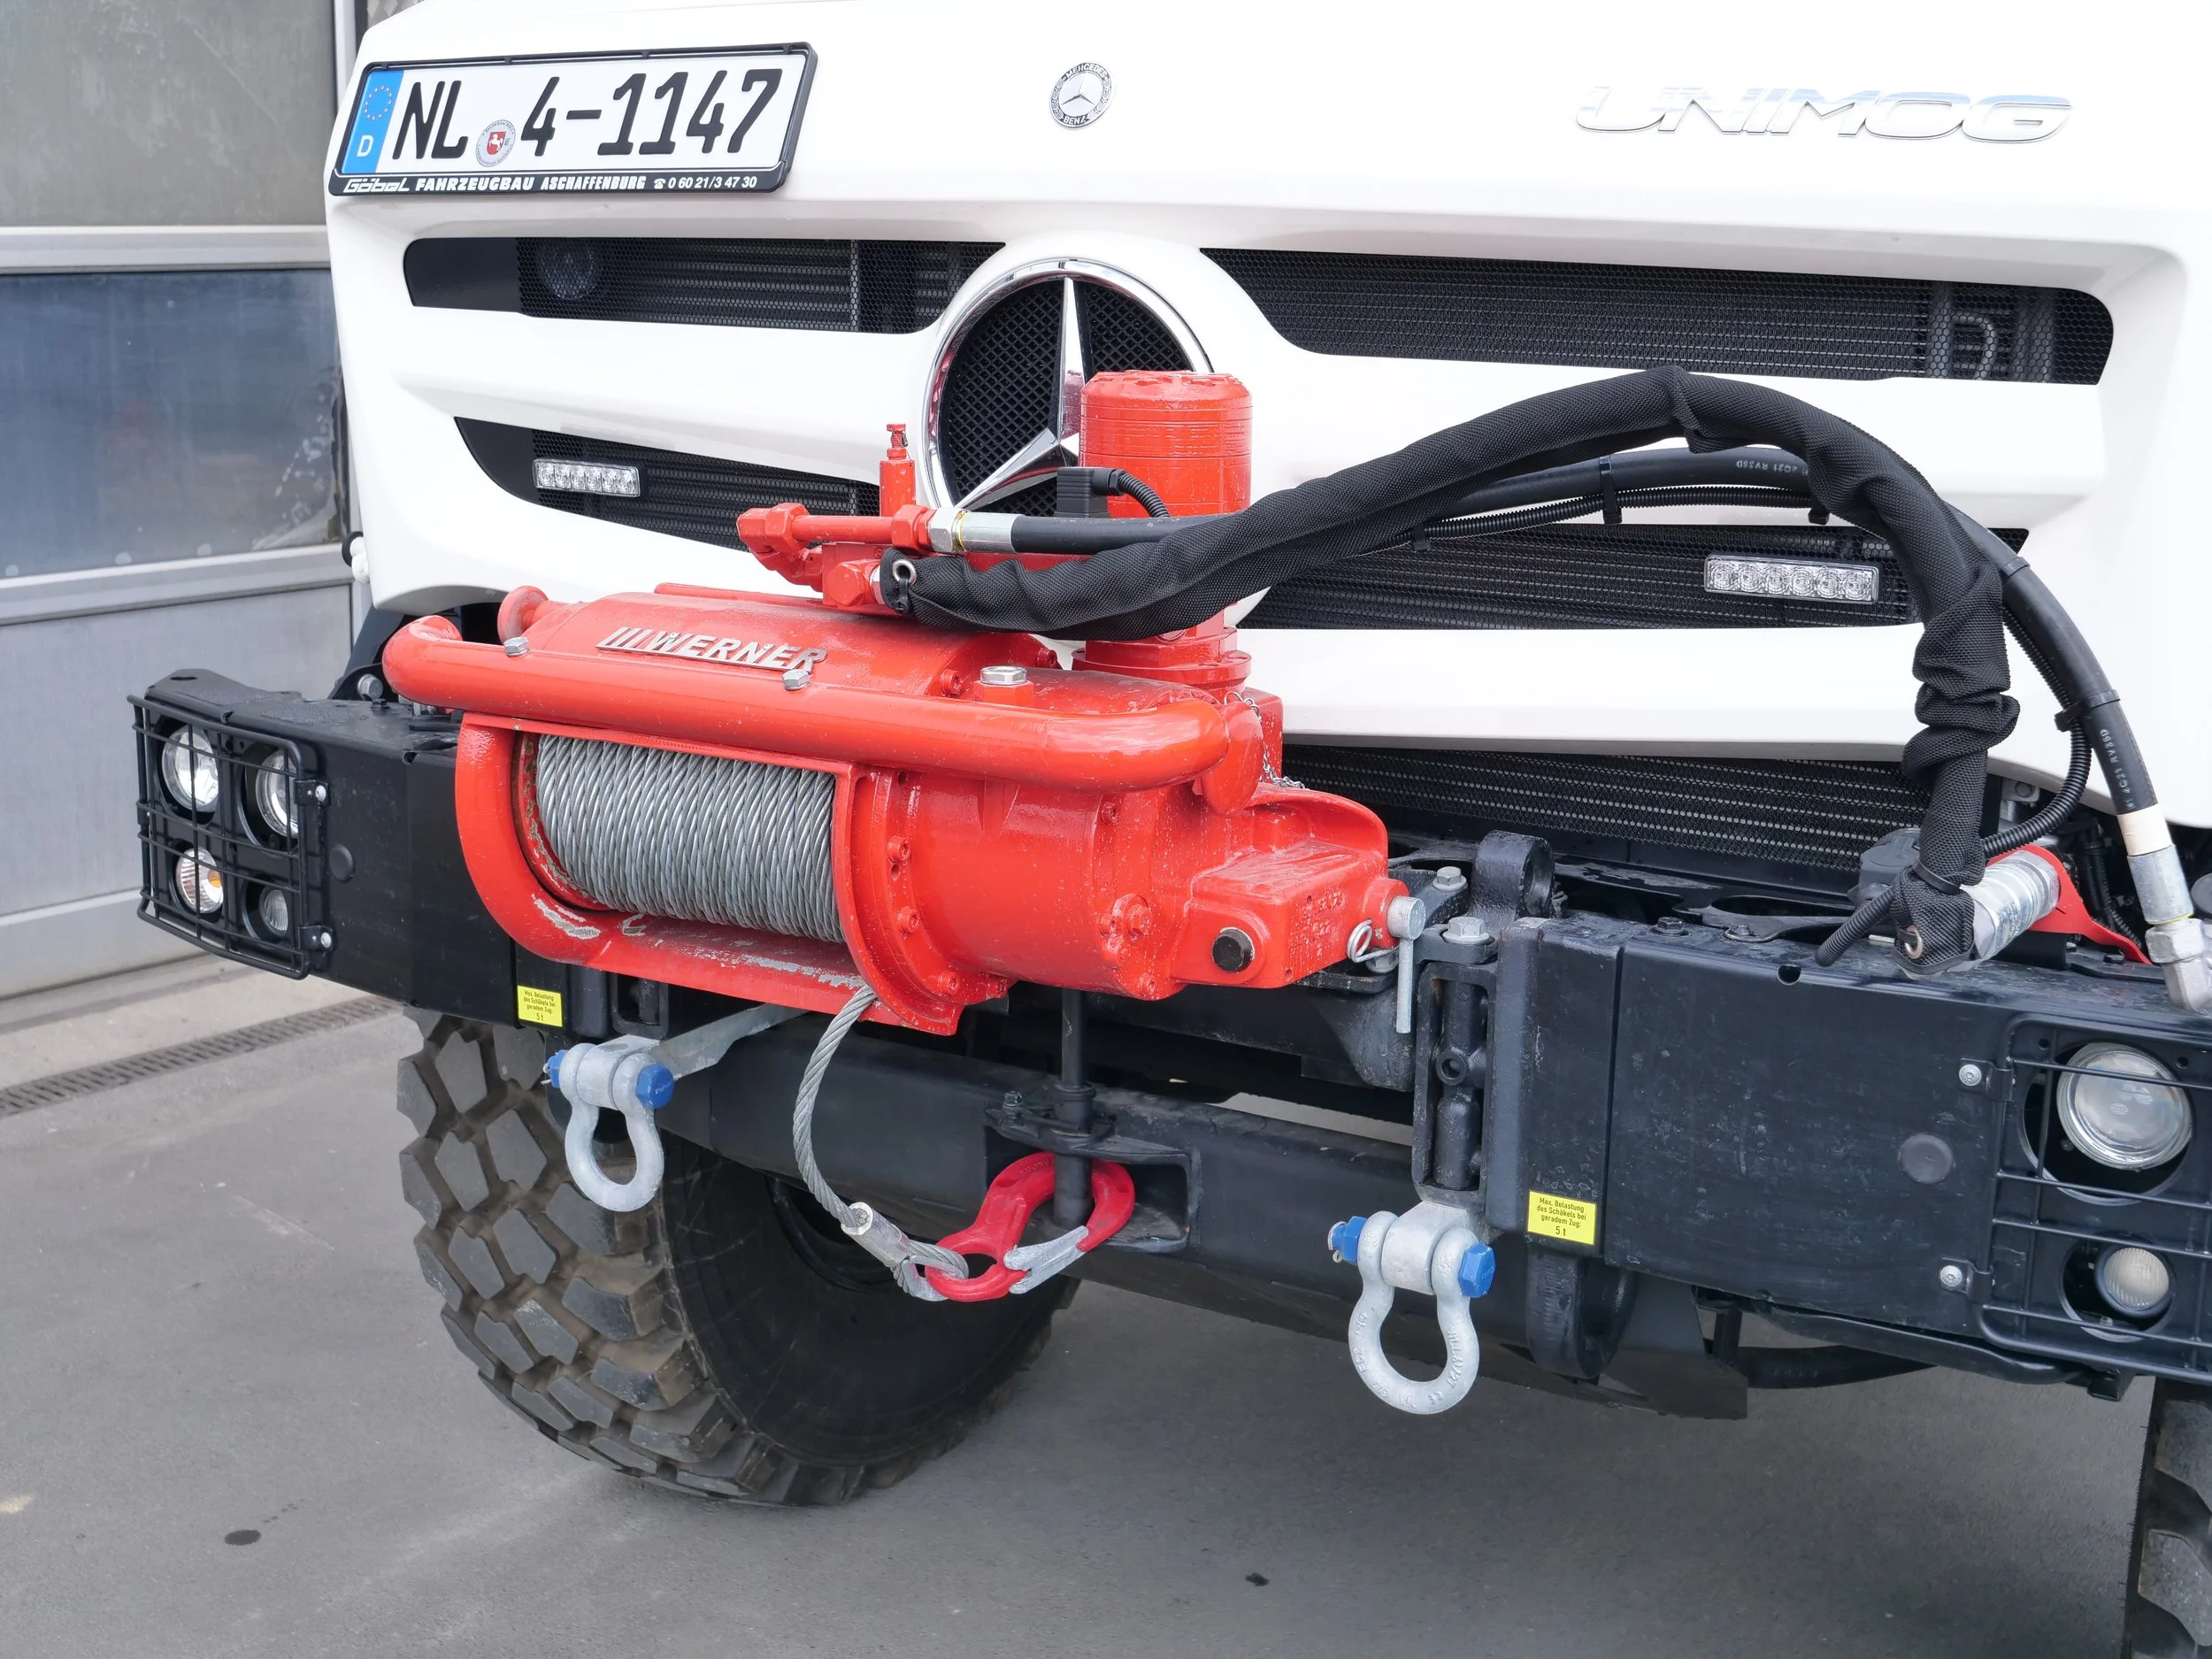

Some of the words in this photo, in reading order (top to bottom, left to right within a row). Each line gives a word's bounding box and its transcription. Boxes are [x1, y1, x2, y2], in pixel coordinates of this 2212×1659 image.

[1065, 63, 1107, 78] MERCEDES
[392, 81, 469, 159] NL
[520, 68, 782, 157] 4-1147
[1063, 115, 1087, 126] BENZ
[1576, 86, 2073, 144] UNIMOG
[357, 135, 373, 157] D
[415, 177, 535, 192] FAHRZEUGBAU
[540, 176, 647, 190] ASCHAFFENBURG
[678, 177, 692, 189] 60
[725, 176, 738, 188] 47
[741, 176, 757, 188] 30
[644, 630, 828, 674] WERNER
[1540, 1196, 1554, 1206] Max.
[1555, 1200, 1585, 1213] Belastung
[1548, 1208, 1576, 1218] Schäkels
[1540, 1214, 1568, 1225] geradem
[1569, 1218, 1581, 1229] Zug:
[1555, 1225, 1561, 1235] 5
[1563, 1227, 1567, 1237] t
